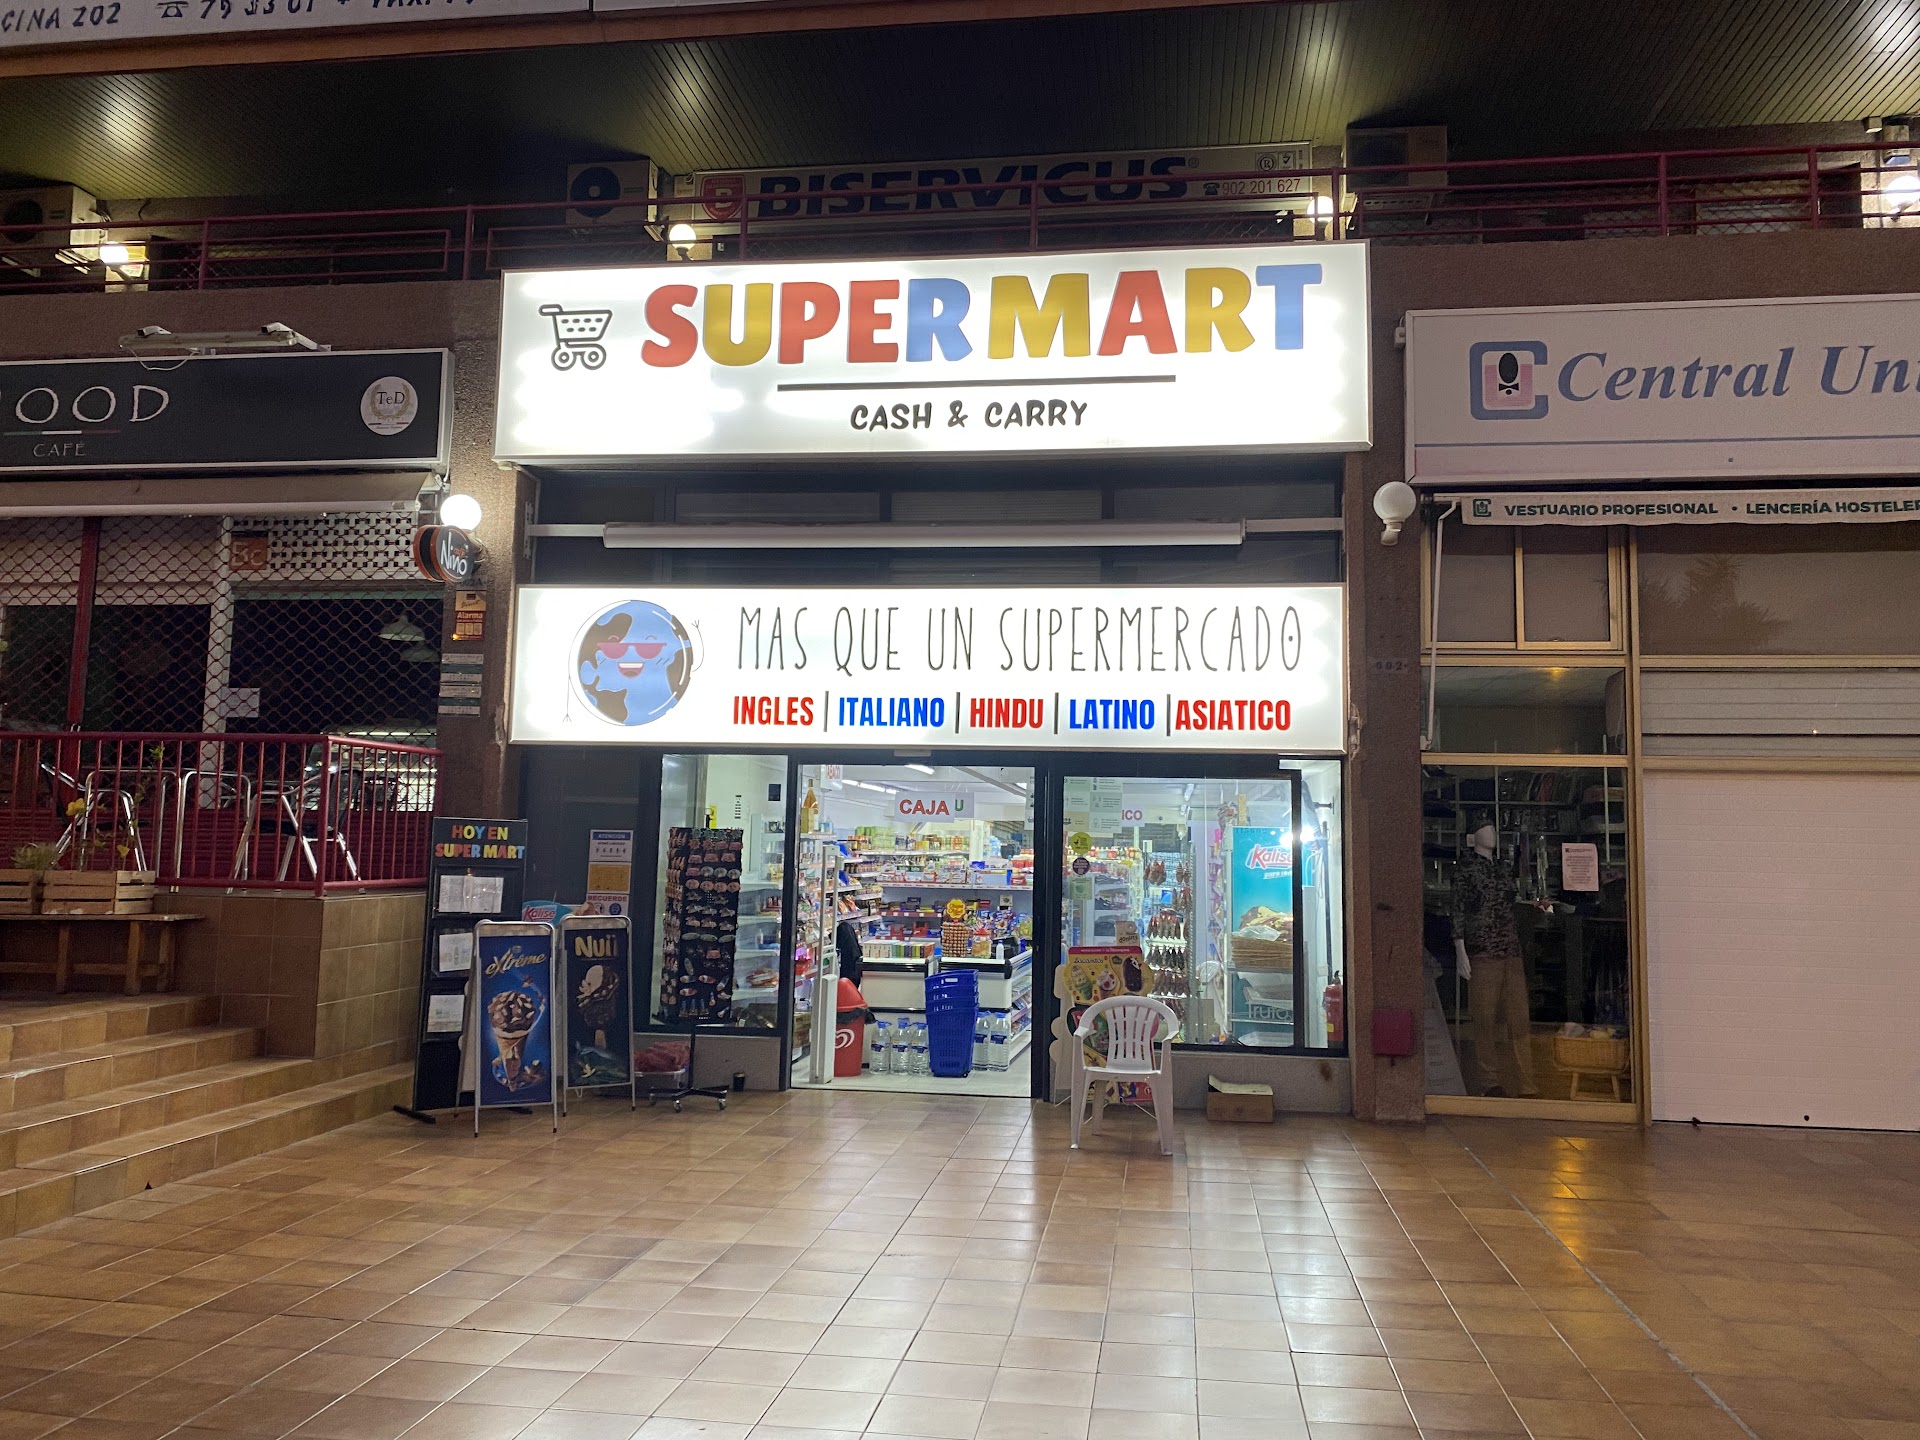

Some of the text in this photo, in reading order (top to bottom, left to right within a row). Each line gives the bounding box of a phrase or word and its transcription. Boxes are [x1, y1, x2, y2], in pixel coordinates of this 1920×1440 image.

[72, 3, 121, 27] 202
[757, 156, 1188, 218] BISERVICUS
[1222, 178, 1301, 195] 902 201 627
[640, 263, 1323, 368] SUPERMART
[1557, 346, 1795, 402] Central
[0, 385, 170, 424] OOD
[376, 391, 405, 405] TeD
[850, 399, 1088, 431] CASH & CARRY
[1504, 504, 1598, 517] VESTUARIO
[1602, 502, 1718, 516] PROFESIONAL
[1746, 499, 1832, 515] LENCERÍA
[441, 531, 468, 576] Nino
[457, 611, 483, 620] Alarma
[737, 605, 1302, 677] MAS QUE UN SUPERMERCADO
[733, 695, 1292, 731] INGLES ITALIANO HINDU LATINO ASIATICO
[899, 799, 950, 816] CAJA
[451, 824, 509, 841] HOY EN
[434, 843, 525, 860] SUPER MART
[523, 906, 557, 920] Kalise
